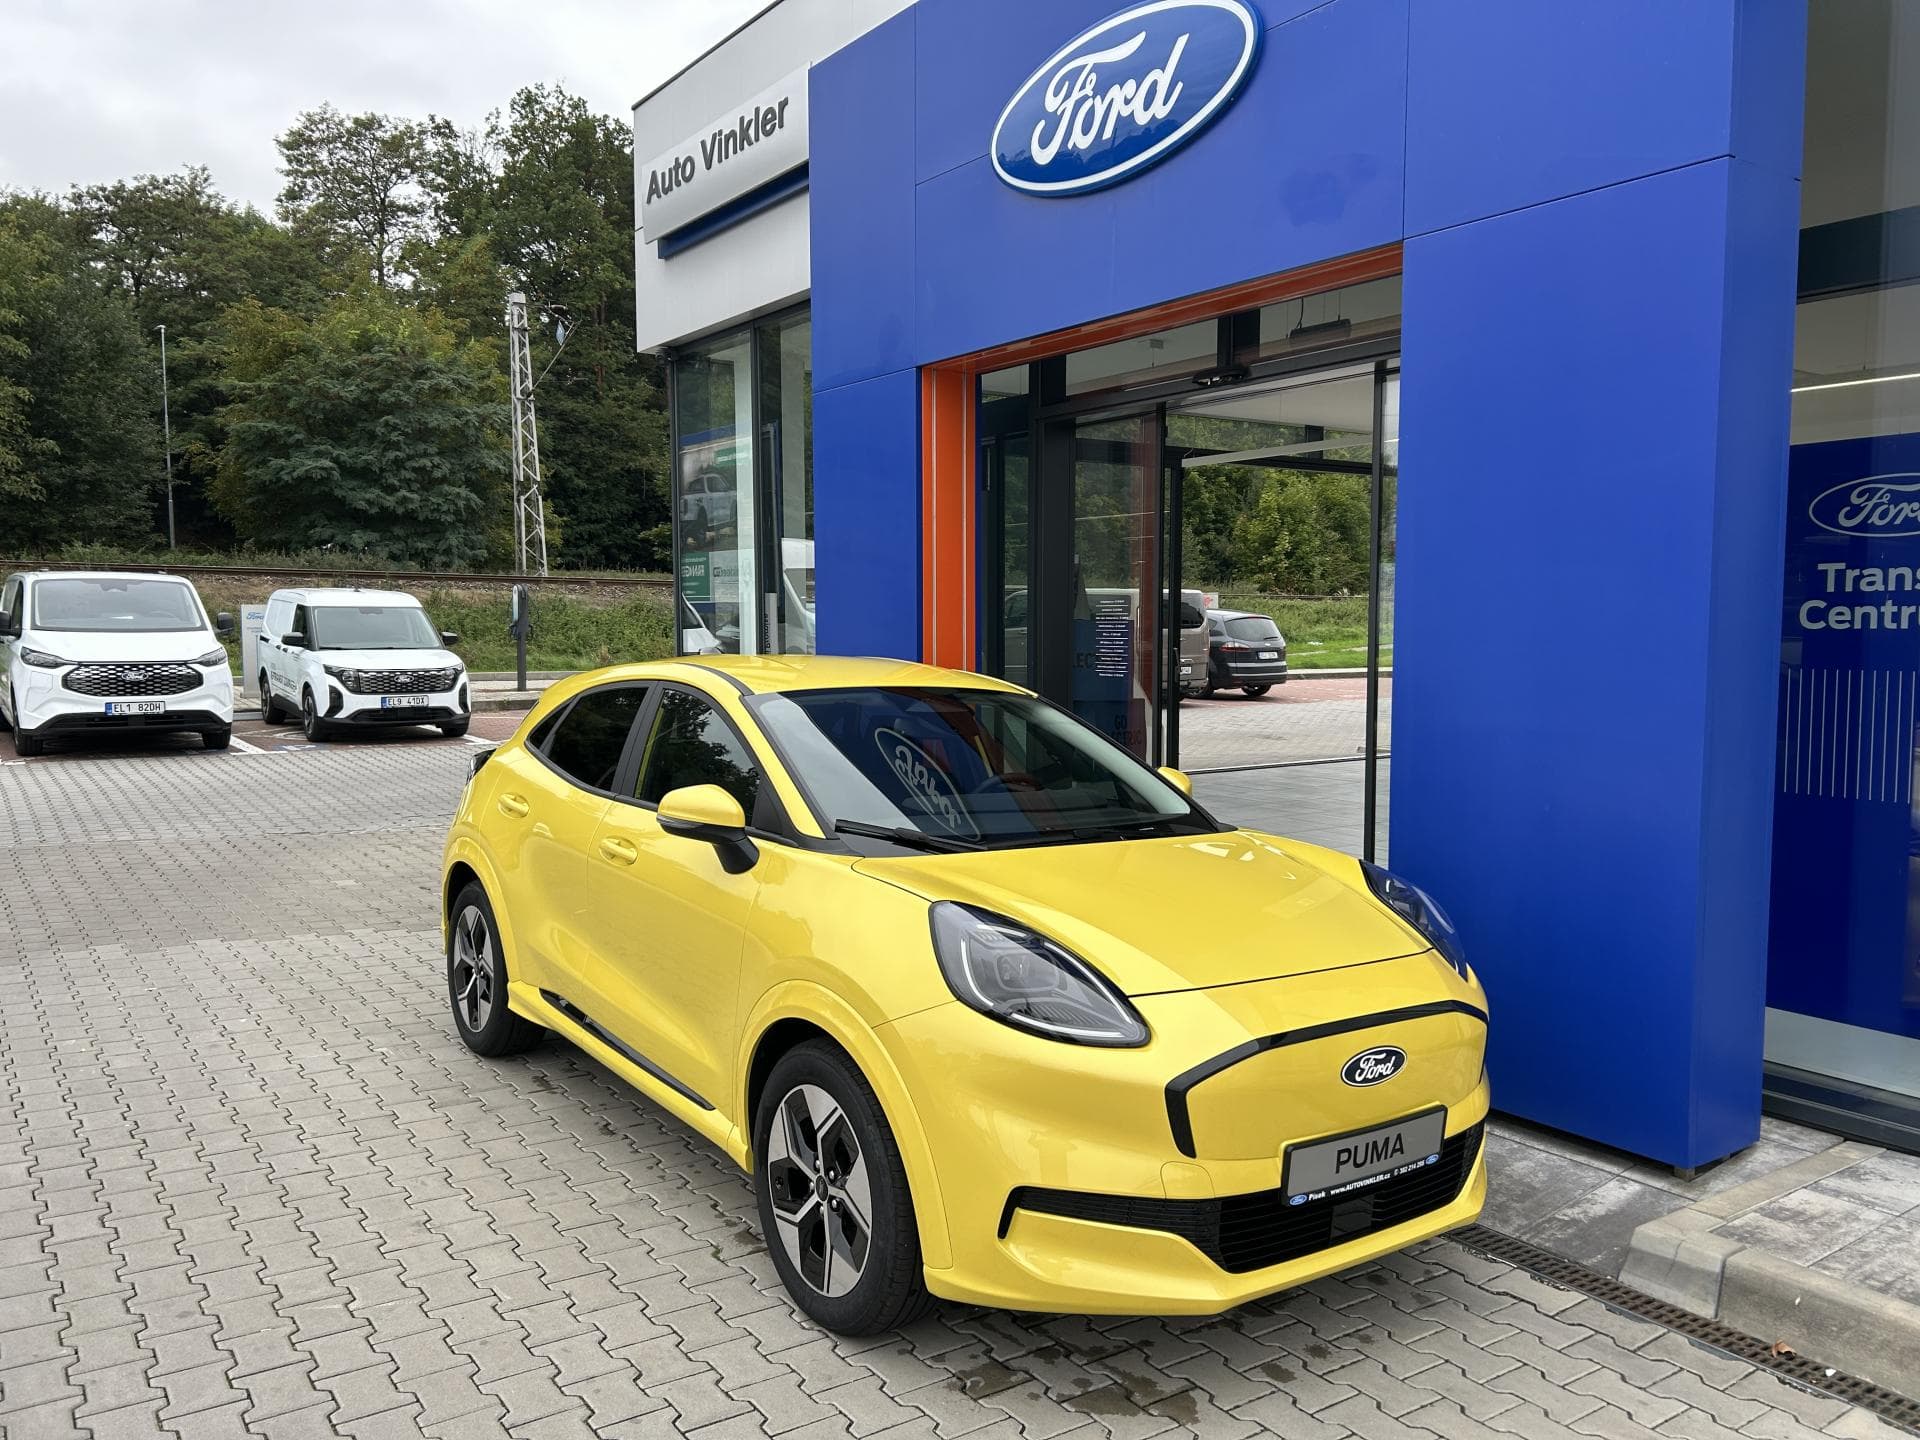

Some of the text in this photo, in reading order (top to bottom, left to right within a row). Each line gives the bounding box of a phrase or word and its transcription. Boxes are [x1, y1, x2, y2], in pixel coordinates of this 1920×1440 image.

[1030, 31, 1190, 166] Ford
[645, 96, 790, 205] Auto Vinkler
[1837, 483, 1920, 528] For
[1799, 600, 1920, 630] Centr
[113, 703, 161, 713] EL1 82DH
[388, 698, 402, 706] EL9
[1355, 1052, 1395, 1082] Ford
[1334, 1132, 1405, 1174] PUMA
